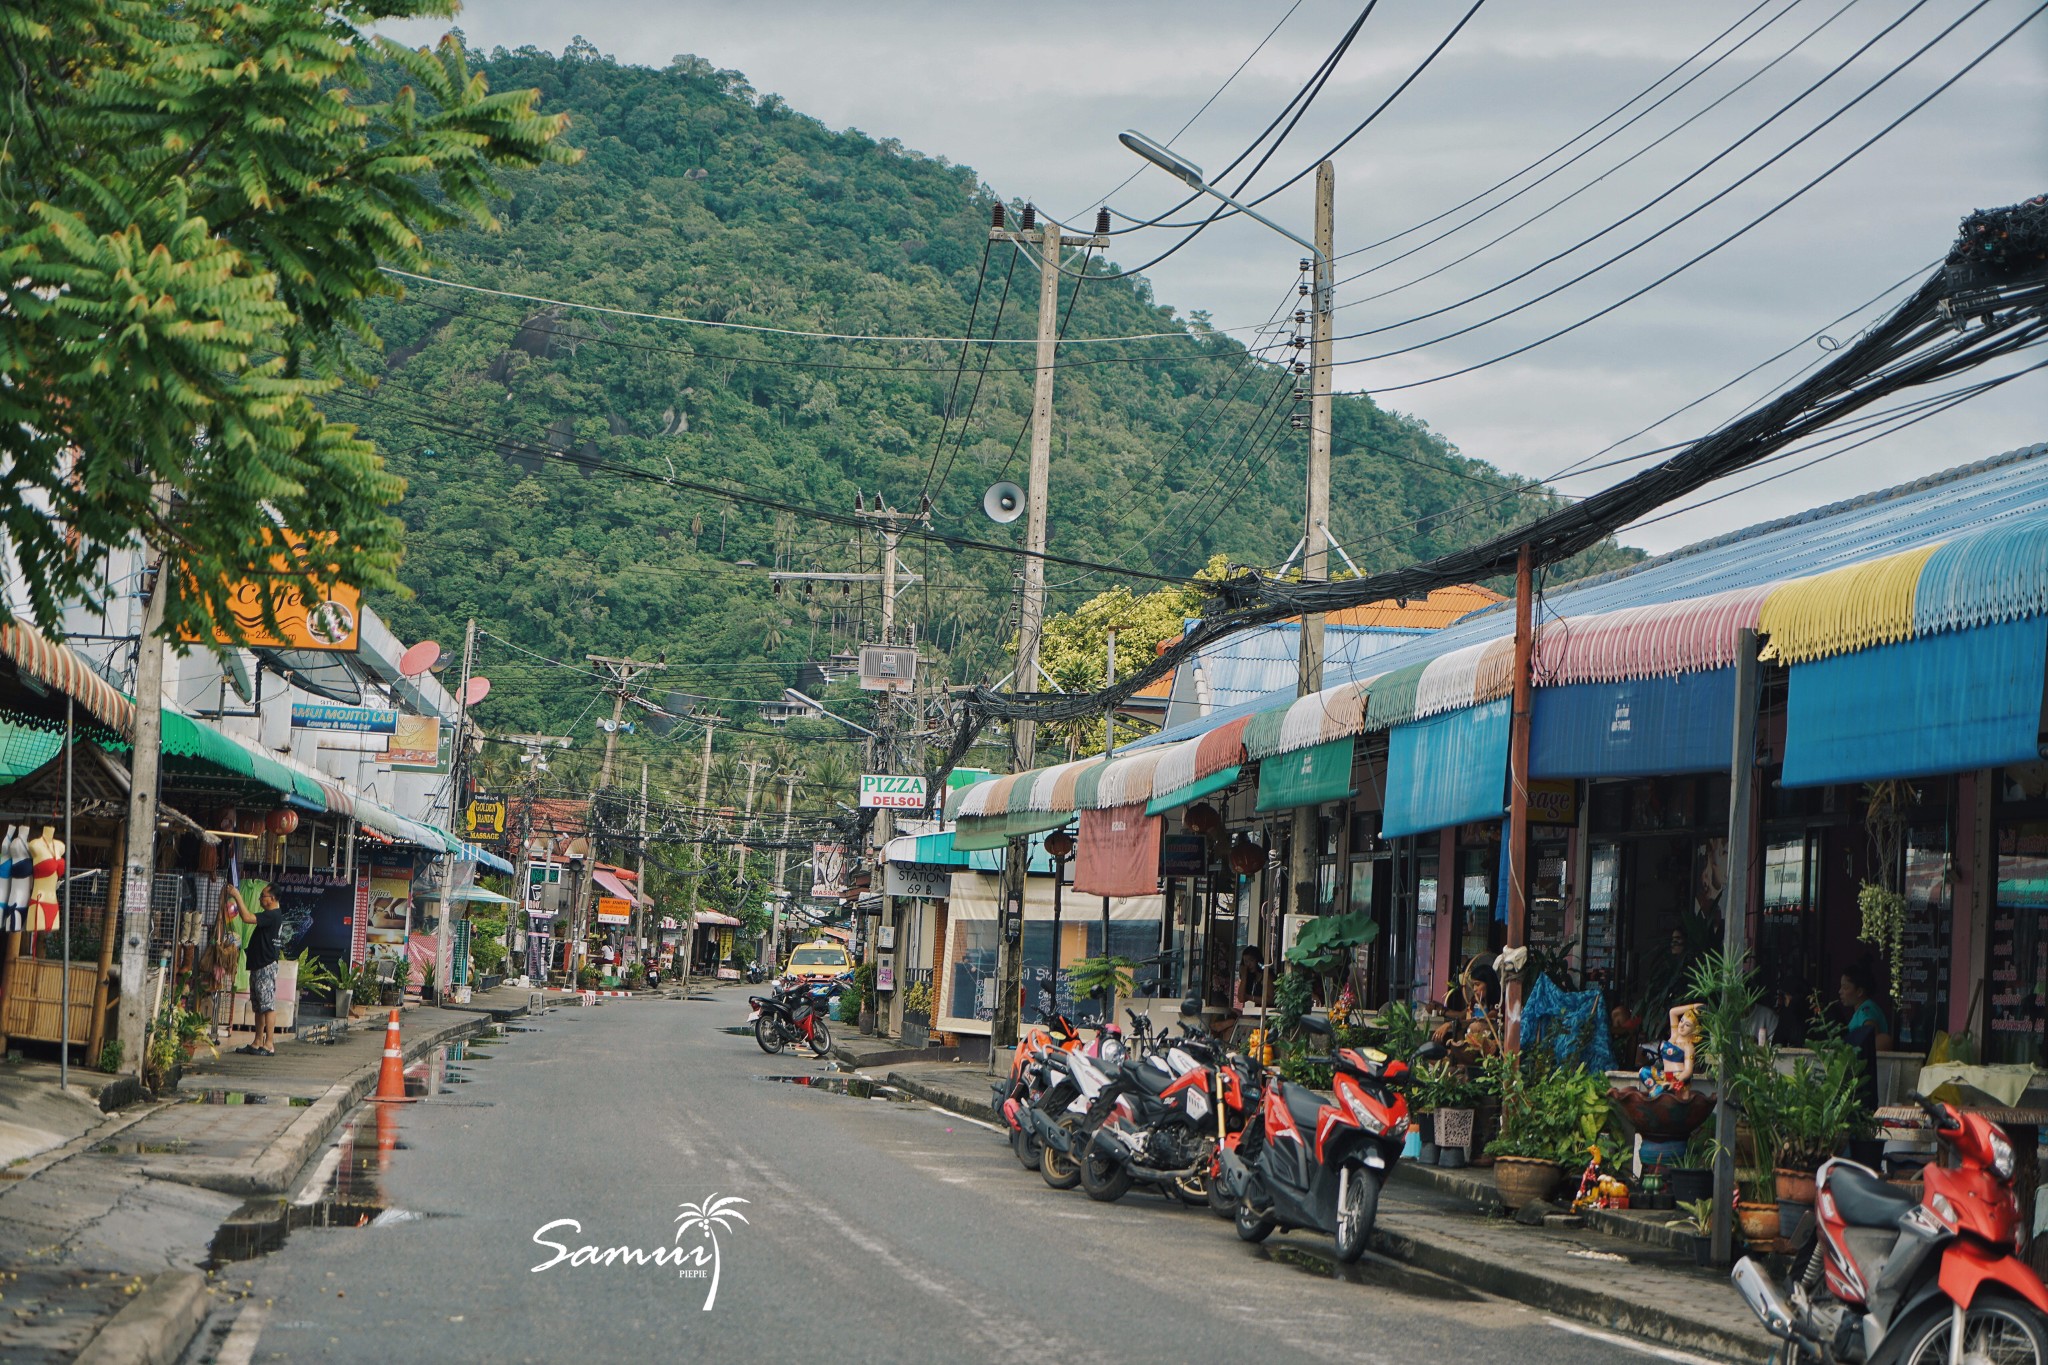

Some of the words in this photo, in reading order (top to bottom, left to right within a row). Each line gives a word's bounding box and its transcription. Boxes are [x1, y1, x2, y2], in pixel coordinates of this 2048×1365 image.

[324, 709, 371, 721] MOJITO
[371, 711, 395, 724] LAB
[306, 719, 332, 729] Lounge
[339, 722, 358, 730] Wine
[358, 723, 372, 731] Bar
[863, 776, 924, 794] PIZZA
[475, 802, 496, 812] GOLDEN
[873, 796, 924, 807] DELSOL
[470, 832, 500, 840] MASSAGE
[895, 861, 950, 873] COCKTAL
[898, 870, 946, 883] STATION
[907, 884, 921, 894] 69
